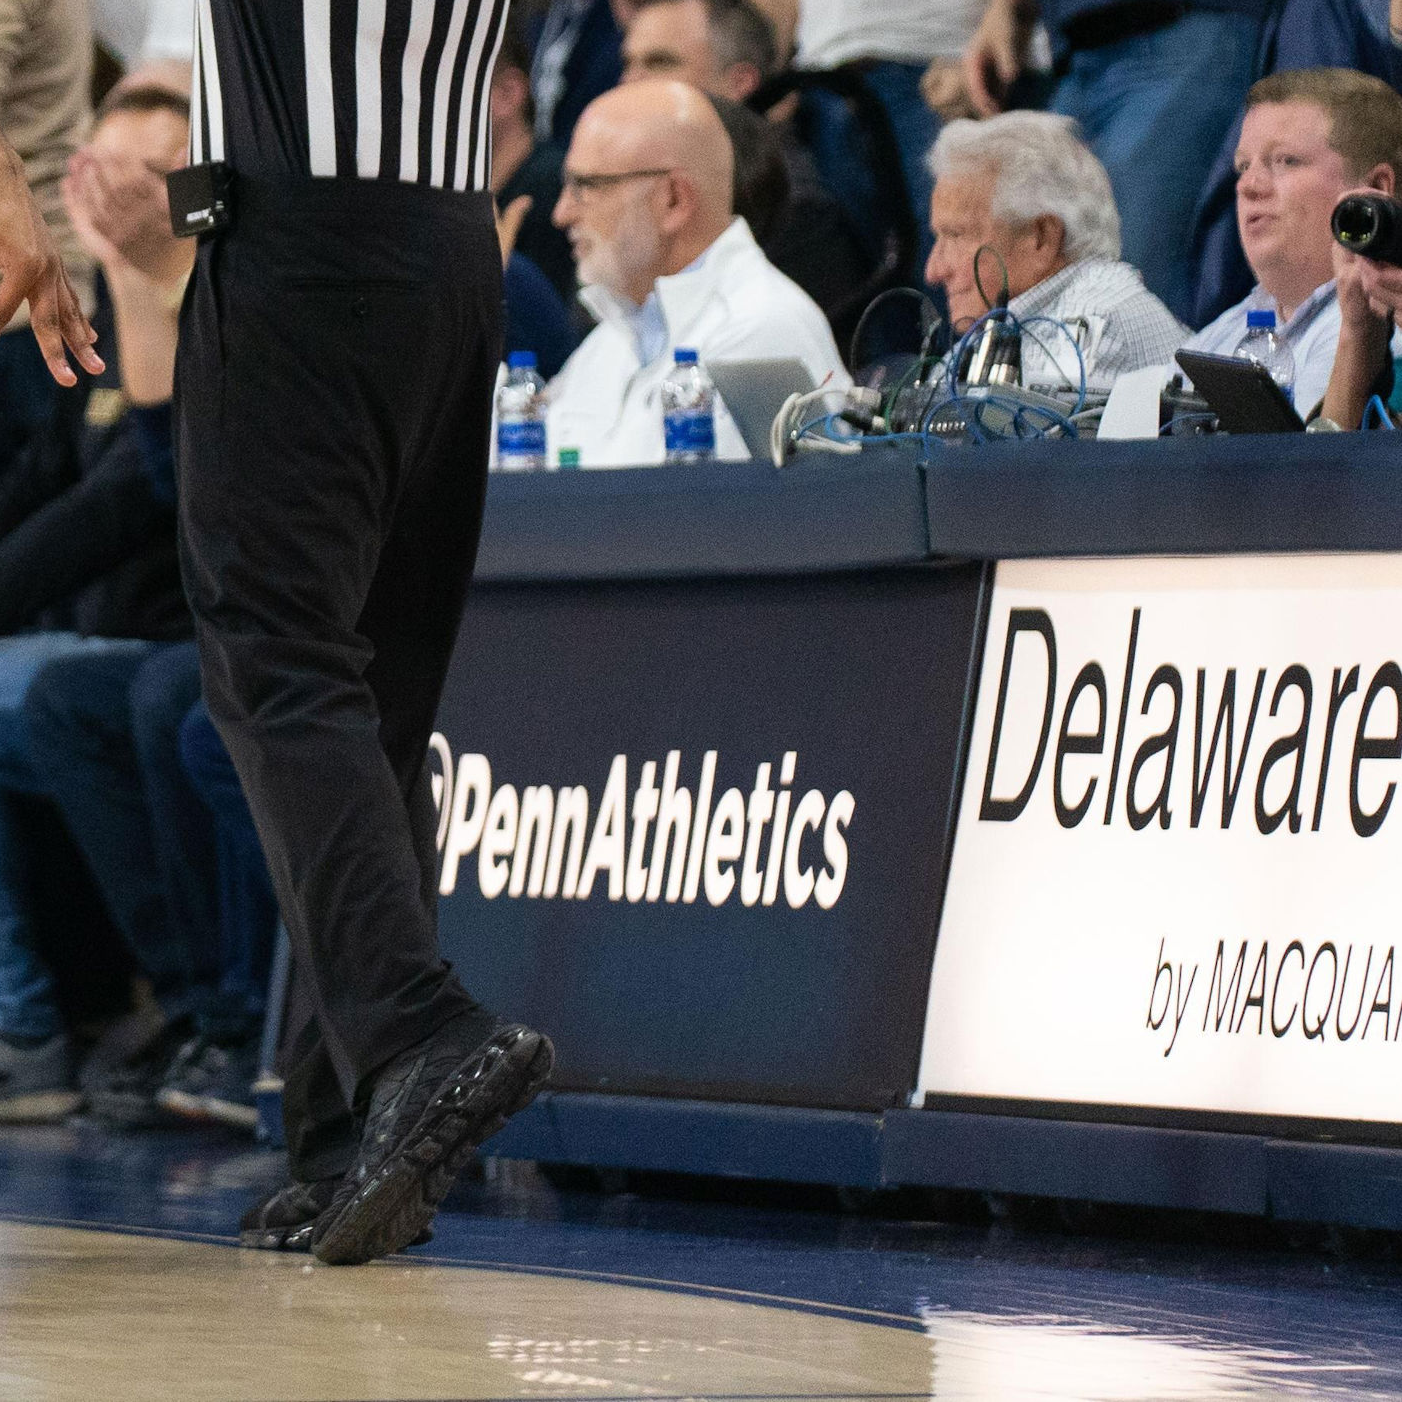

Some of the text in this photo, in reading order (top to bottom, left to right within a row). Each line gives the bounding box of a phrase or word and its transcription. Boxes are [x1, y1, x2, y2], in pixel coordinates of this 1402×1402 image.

[978, 606, 1402, 839] Delaware
[1146, 936, 1402, 1059] by MACQUA
